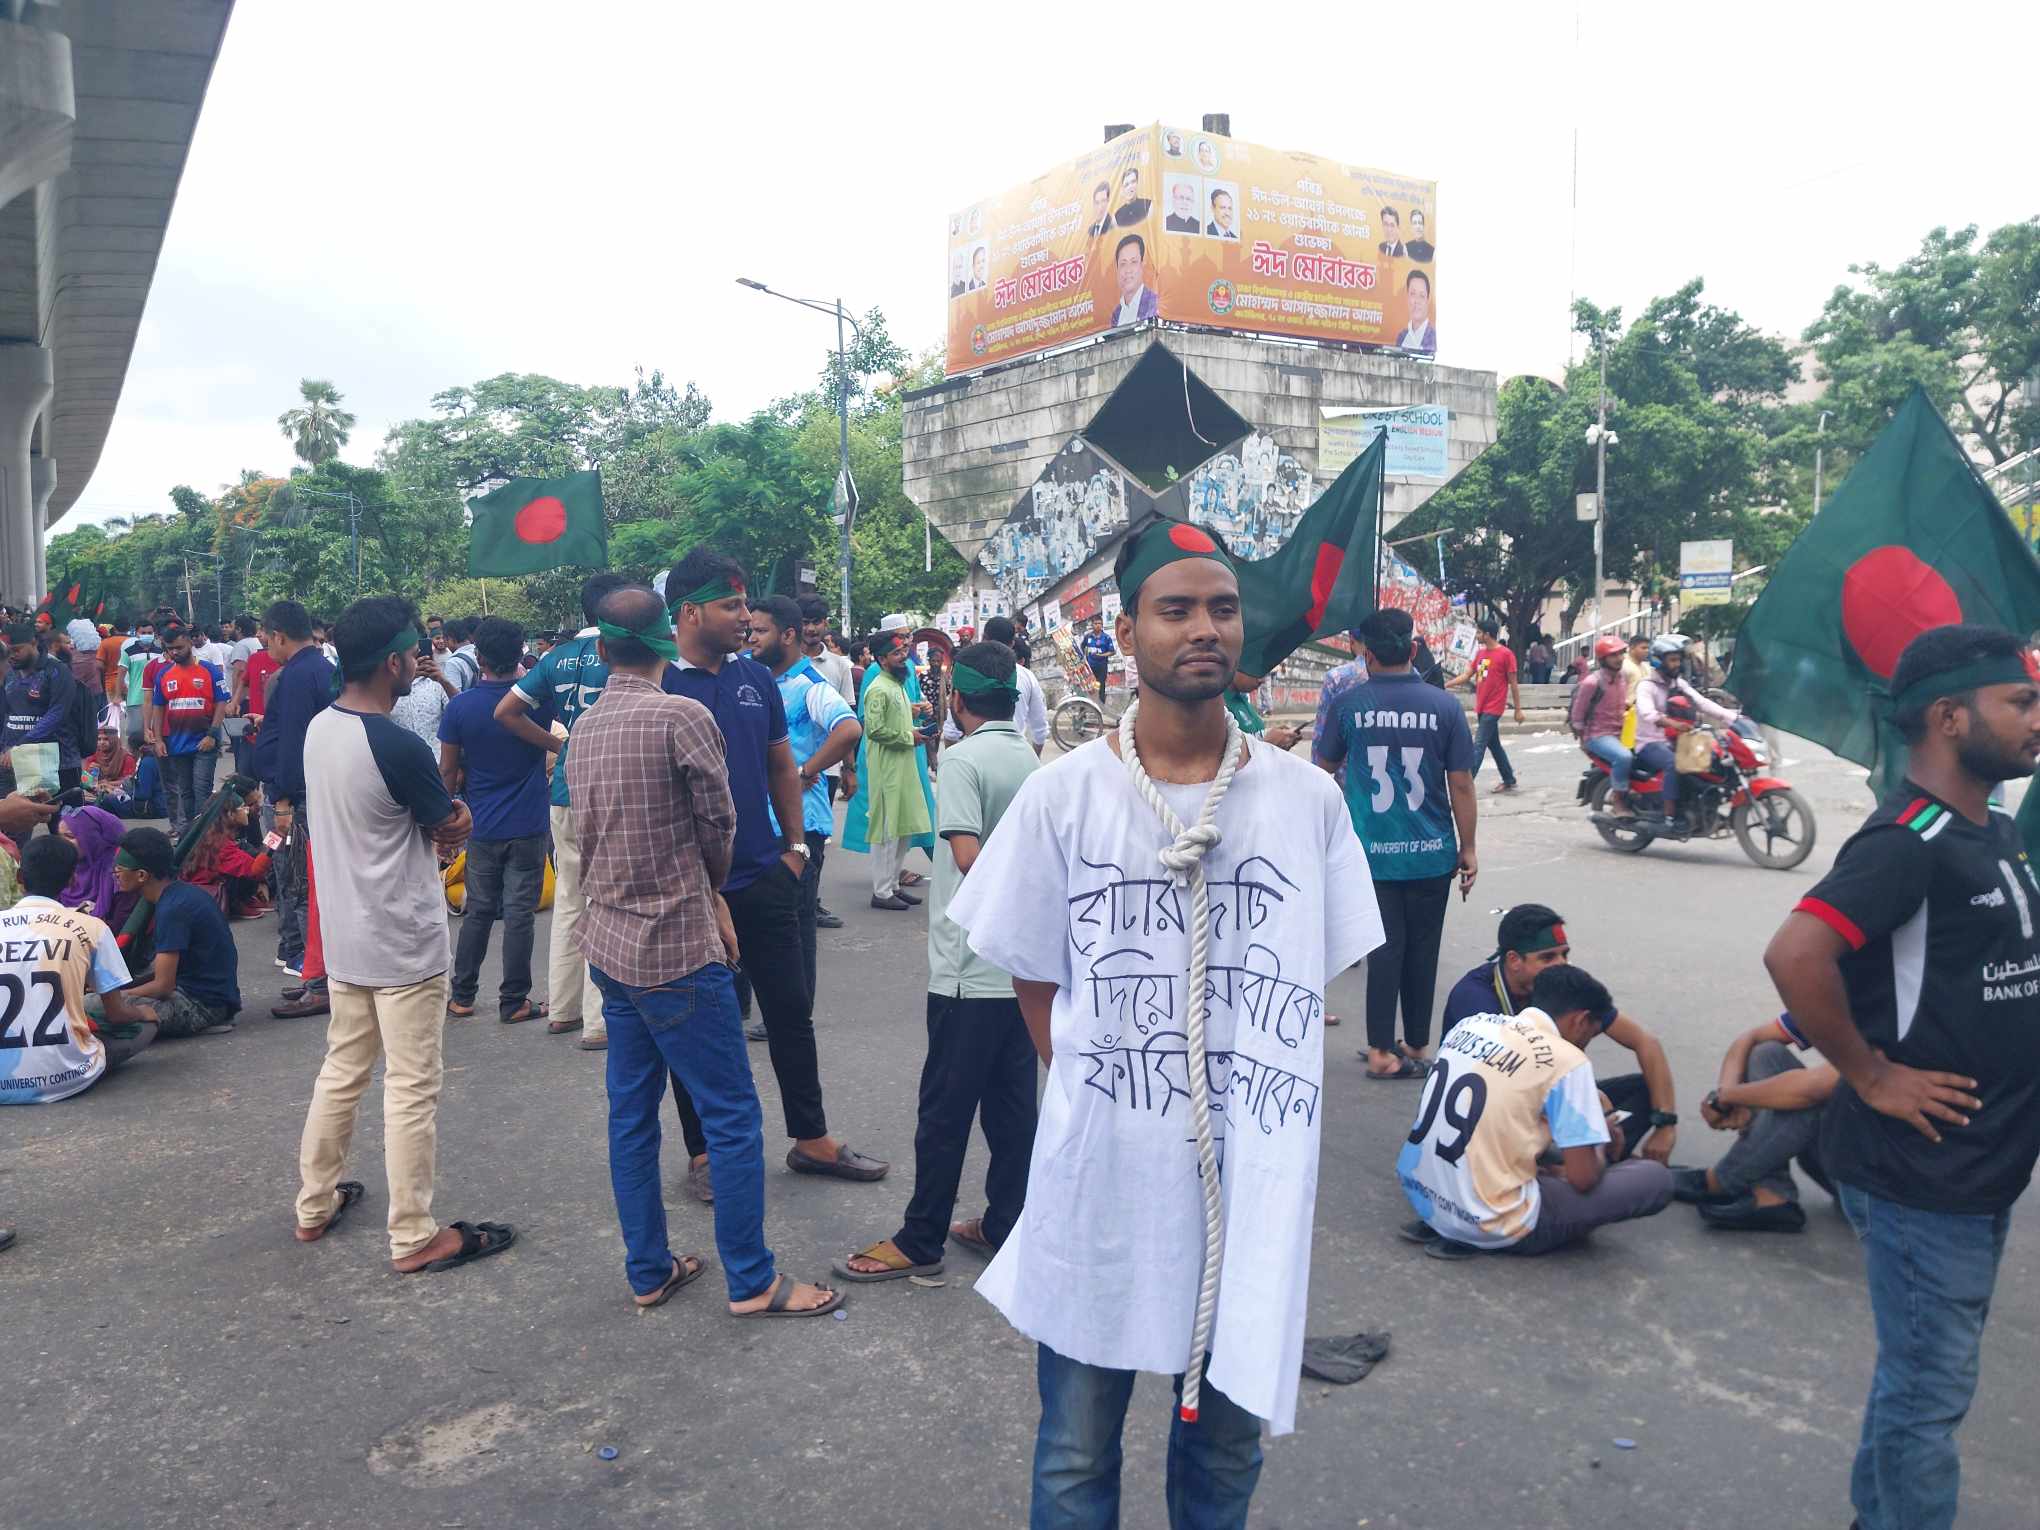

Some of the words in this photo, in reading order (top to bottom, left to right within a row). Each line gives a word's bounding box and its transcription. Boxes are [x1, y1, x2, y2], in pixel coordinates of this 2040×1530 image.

[1252, 241, 1288, 279] ঈদ
[1293, 252, 1377, 290] মোবারক
[994, 276, 1017, 309] ঈদ
[1020, 255, 1085, 300] মোবারক
[1401, 411, 1443, 425] SCHOOL
[1355, 710, 1438, 731] ISMAIL
[1367, 745, 1425, 814] 33
[1370, 841, 1409, 854] UNIVERSITY
[1410, 840, 1420, 853] OF
[35, 913, 61, 925] SAIL
[64, 919, 74, 929] &
[0, 939, 72, 963] EZVI
[1983, 953, 2040, 981] لسطين
[1983, 983, 2023, 1001] BANK
[2024, 979, 2040, 997] OF
[0, 970, 69, 1049] 22
[1, 1075, 47, 1091] UNIVERSITY
[49, 1061, 92, 1085] CONTING
[1408, 1057, 1488, 1168] 09
